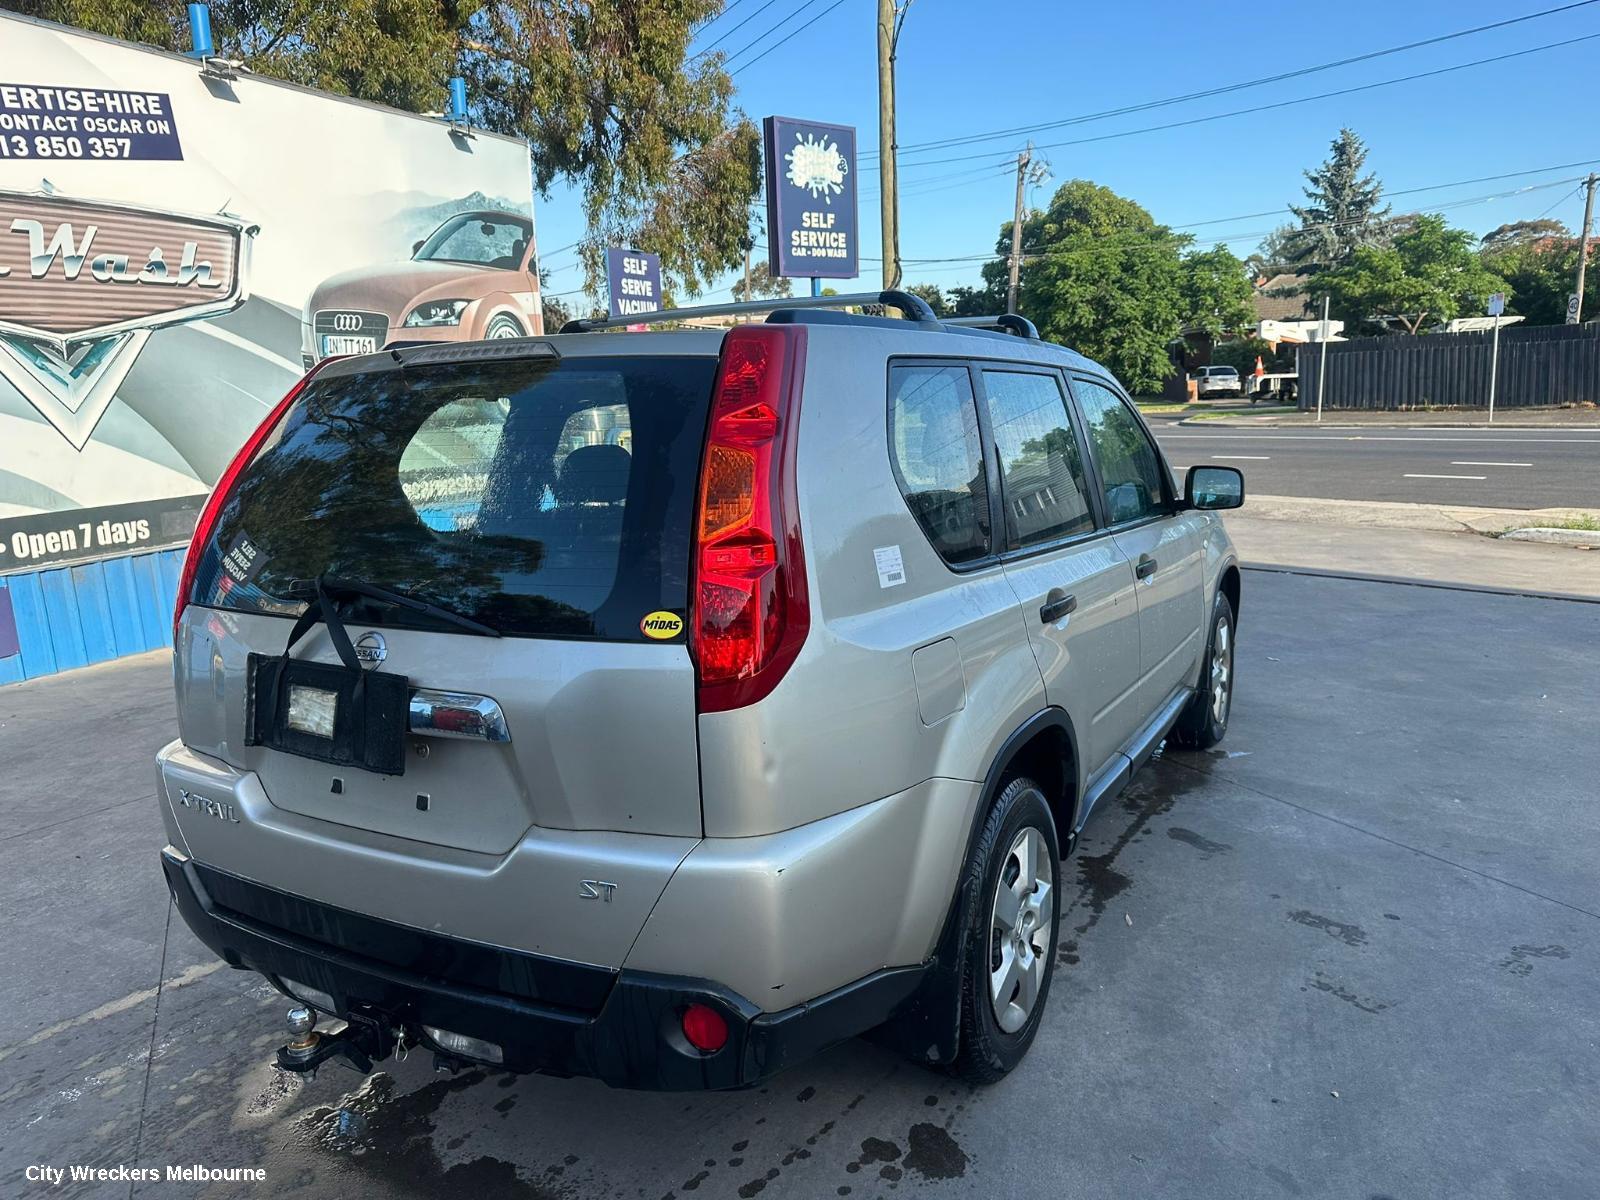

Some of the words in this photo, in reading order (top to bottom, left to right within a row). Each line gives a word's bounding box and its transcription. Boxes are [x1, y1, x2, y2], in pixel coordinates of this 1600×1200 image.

[83, 117, 144, 134] OSCAR
[147, 119, 170, 135] ON
[34, 136, 83, 158] 850
[88, 137, 131, 158] 357
[802, 211, 835, 228] SELF
[791, 230, 847, 248] SERVICE
[10, 218, 222, 288] Wash
[791, 247, 807, 257] CAR
[827, 248, 847, 258] WASH
[623, 257, 648, 275] SELF
[621, 278, 653, 297] SERVE
[618, 298, 658, 315] VACUUM
[11, 528, 77, 559] Open
[79, 522, 92, 548] 7
[96, 519, 151, 545] days
[179, 788, 240, 824] X-TRAIL
[579, 879, 618, 903] ST
